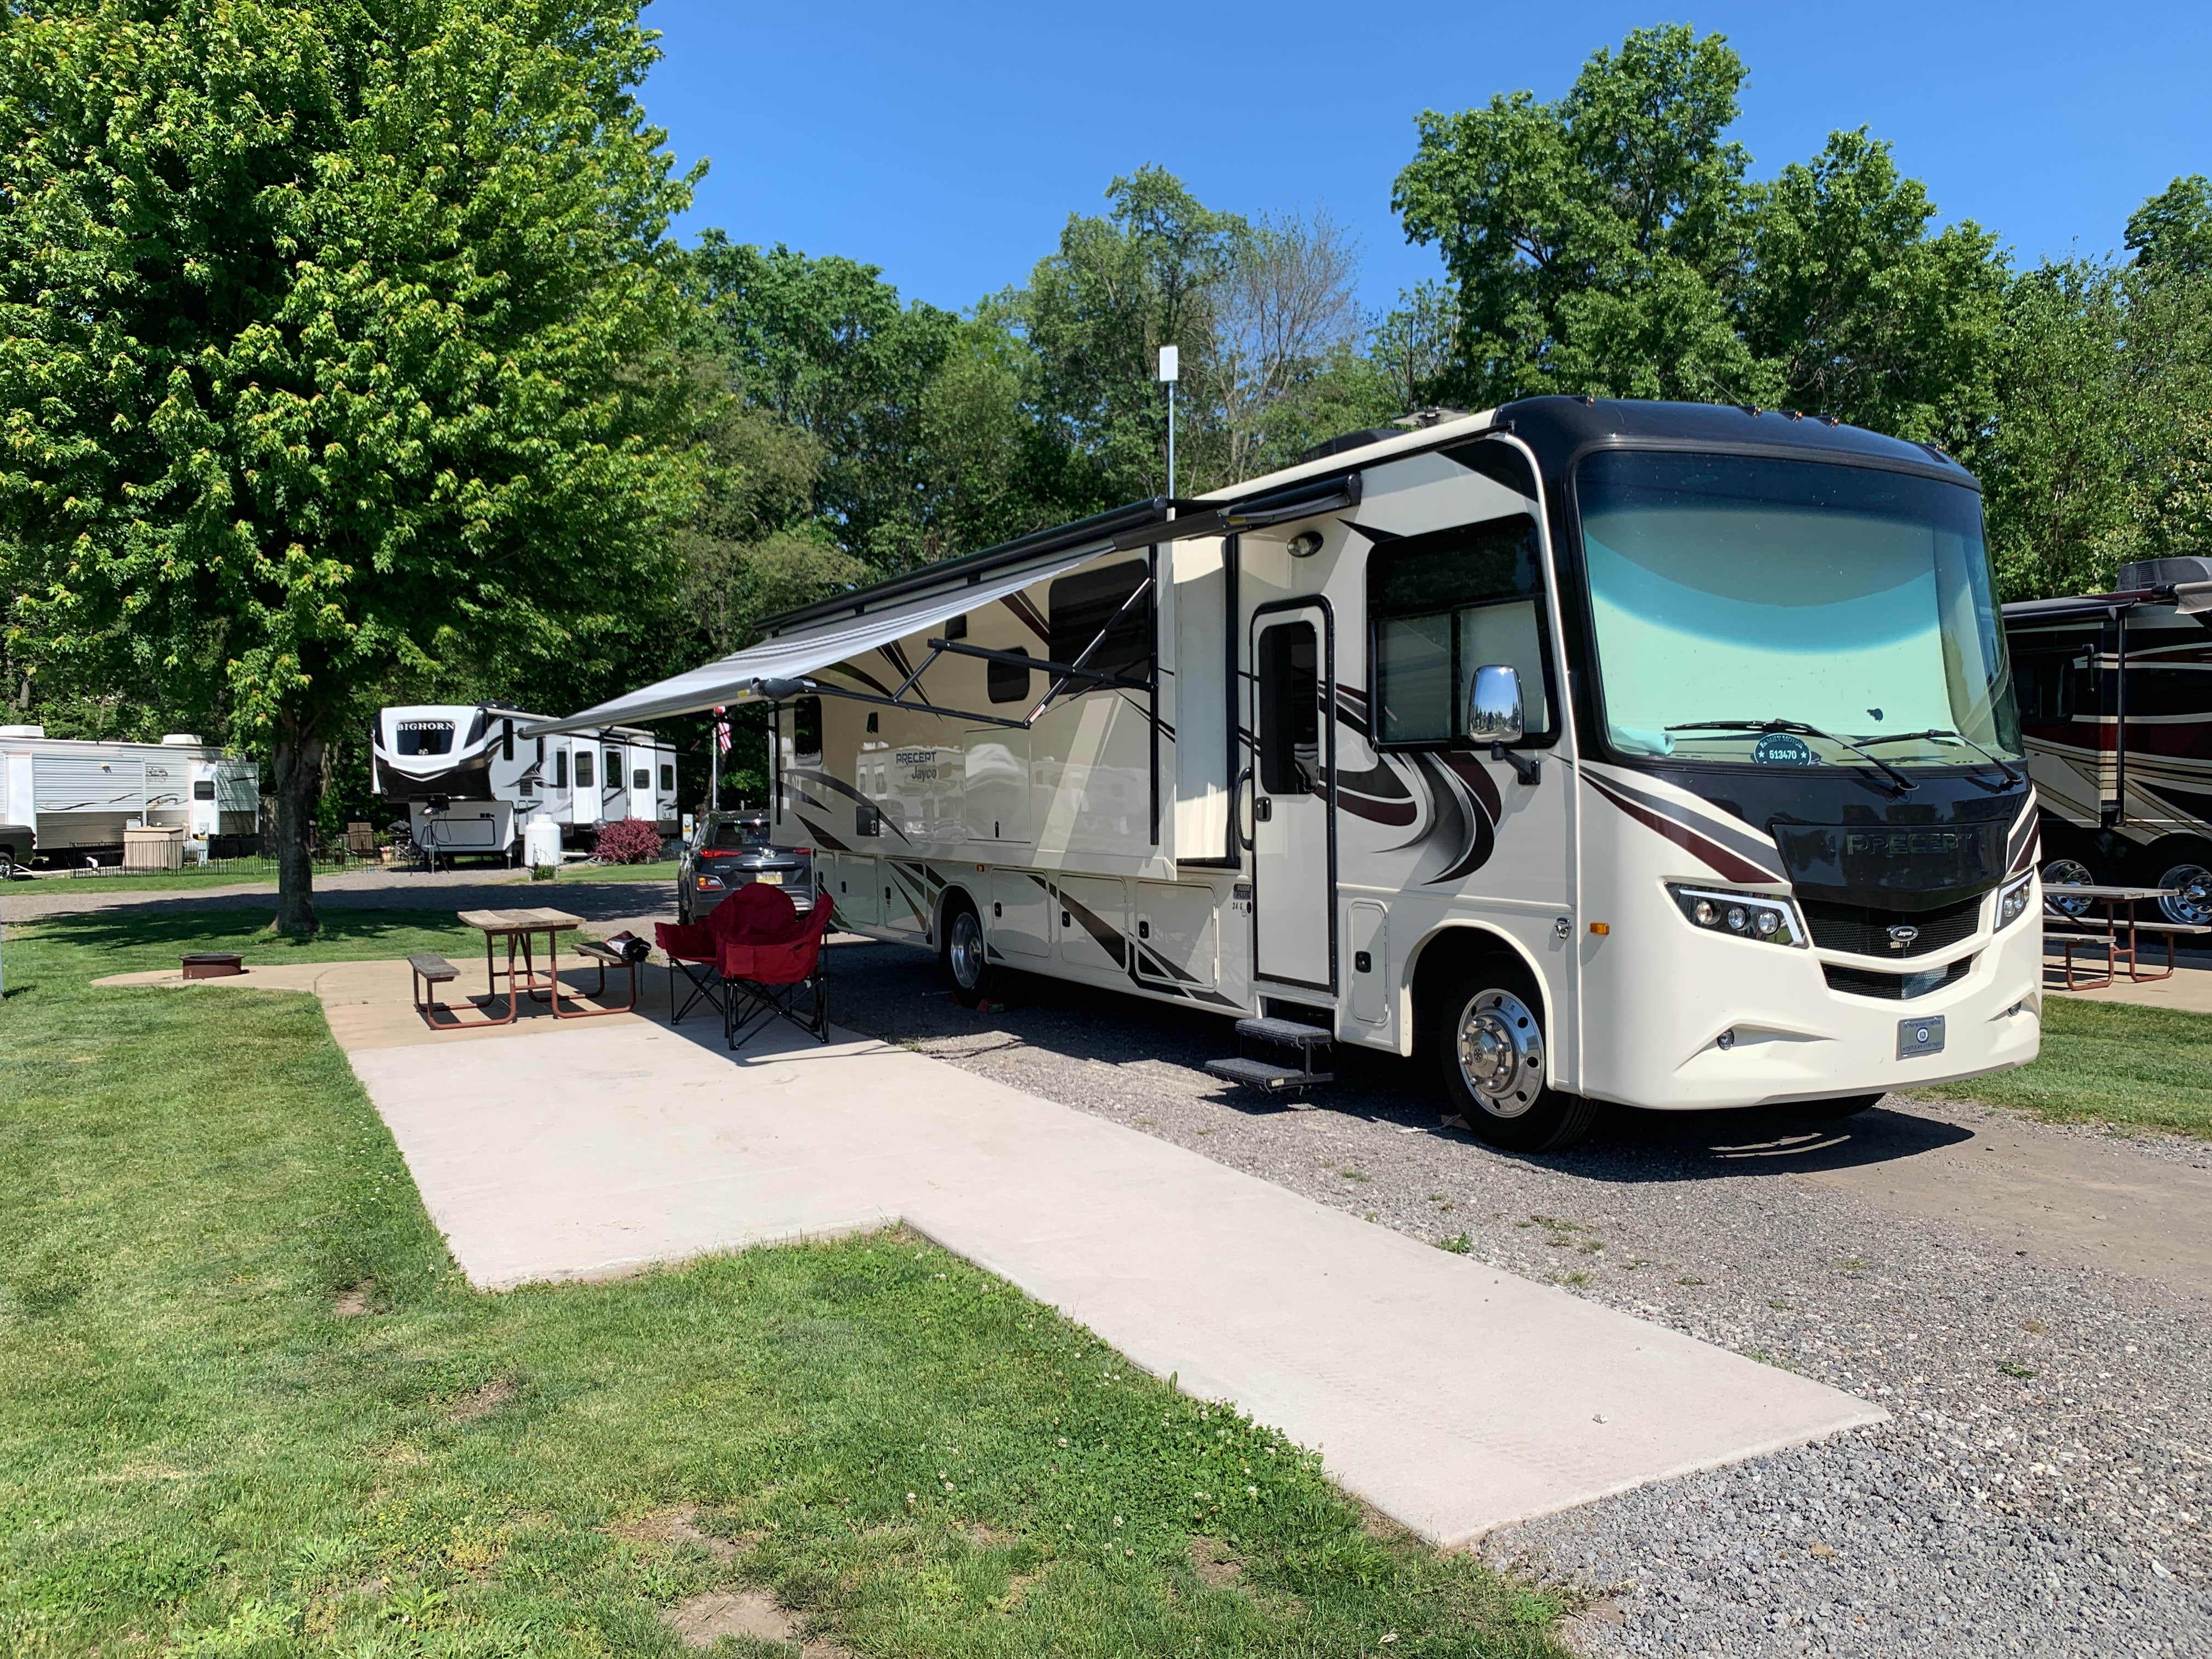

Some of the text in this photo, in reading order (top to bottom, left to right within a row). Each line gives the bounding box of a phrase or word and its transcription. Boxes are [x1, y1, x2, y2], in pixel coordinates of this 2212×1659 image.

[397, 723, 454, 731] BIGHORN
[1759, 736, 1803, 749] FAMILY MOTOR
[896, 752, 936, 765] PRECEPT
[1769, 749, 1797, 759] 513470
[912, 765, 936, 782] Jayco
[1846, 833, 1973, 857] PRECEPT
